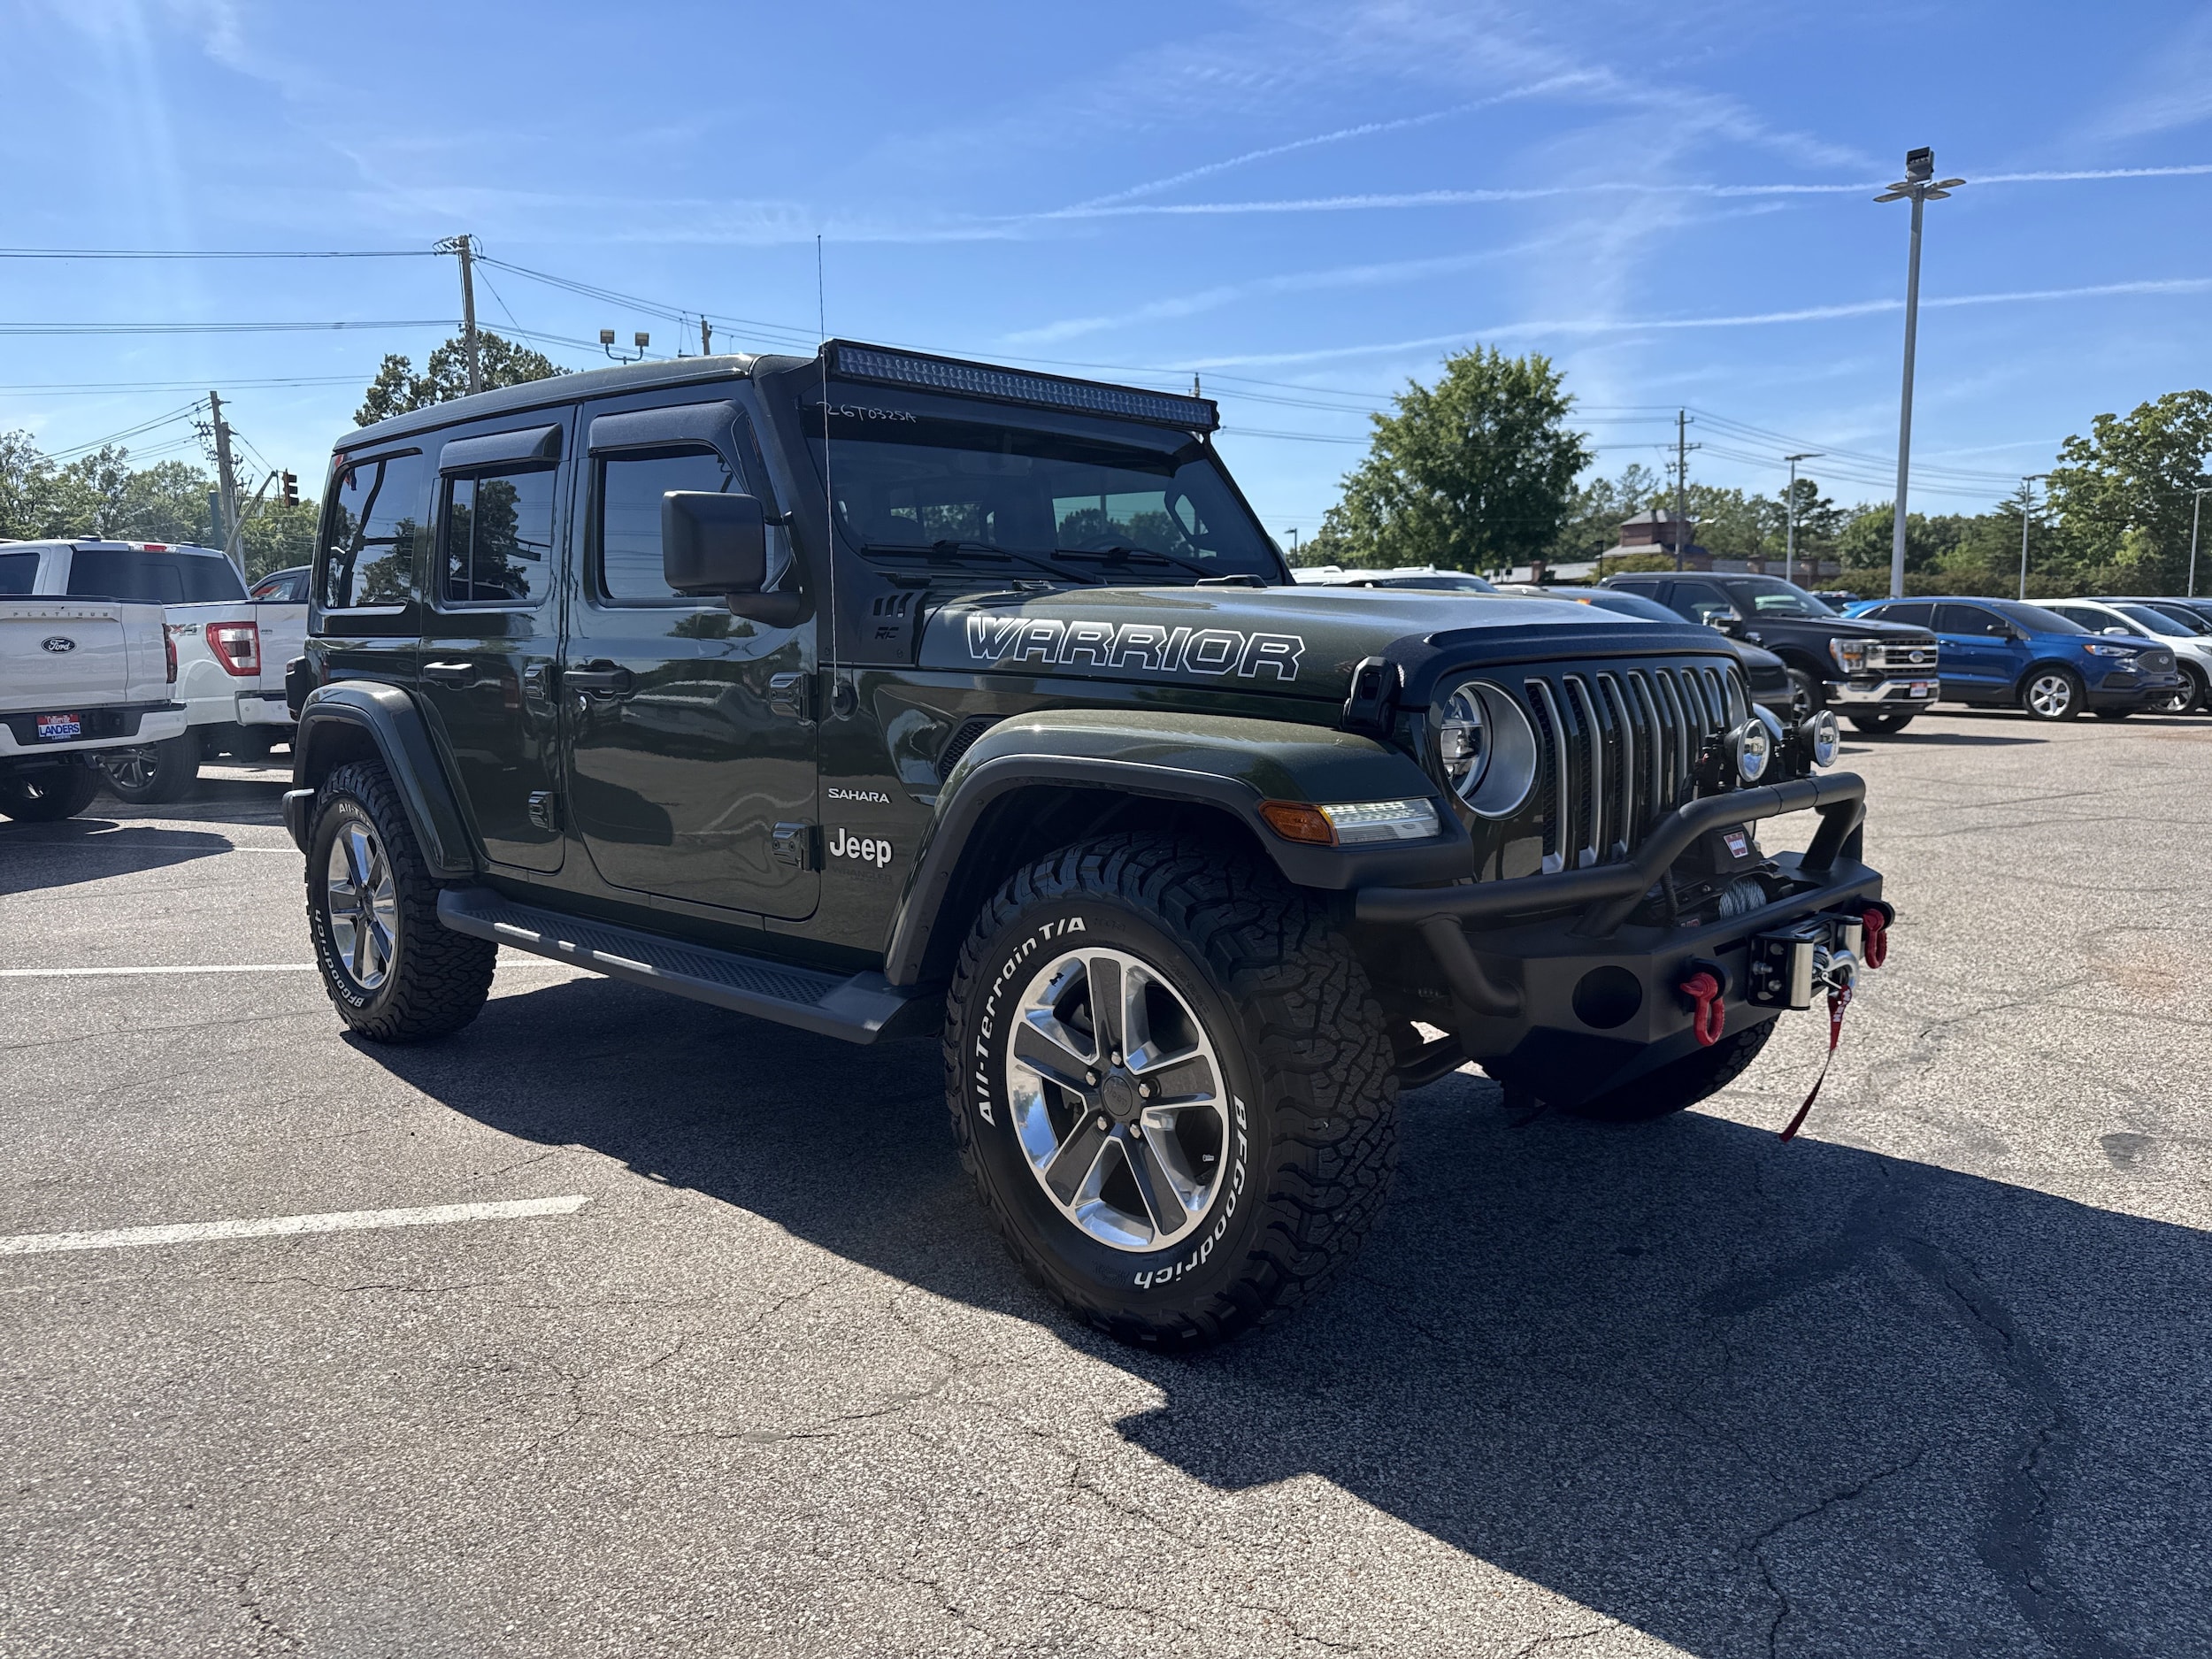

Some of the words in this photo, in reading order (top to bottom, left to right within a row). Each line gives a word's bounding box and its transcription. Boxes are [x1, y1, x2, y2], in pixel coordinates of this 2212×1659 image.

[48, 639, 71, 651] Ford
[966, 616, 1305, 681] WARRIOR
[39, 723, 80, 736] LANDERS
[828, 787, 890, 804] SAHARA
[829, 827, 892, 868] Jeep
[315, 909, 365, 1008] BFGoodrich
[975, 937, 1038, 1127] All-Terrain
[1039, 917, 1087, 941] T/A
[1133, 1094, 1248, 1289] BFGoodrich
